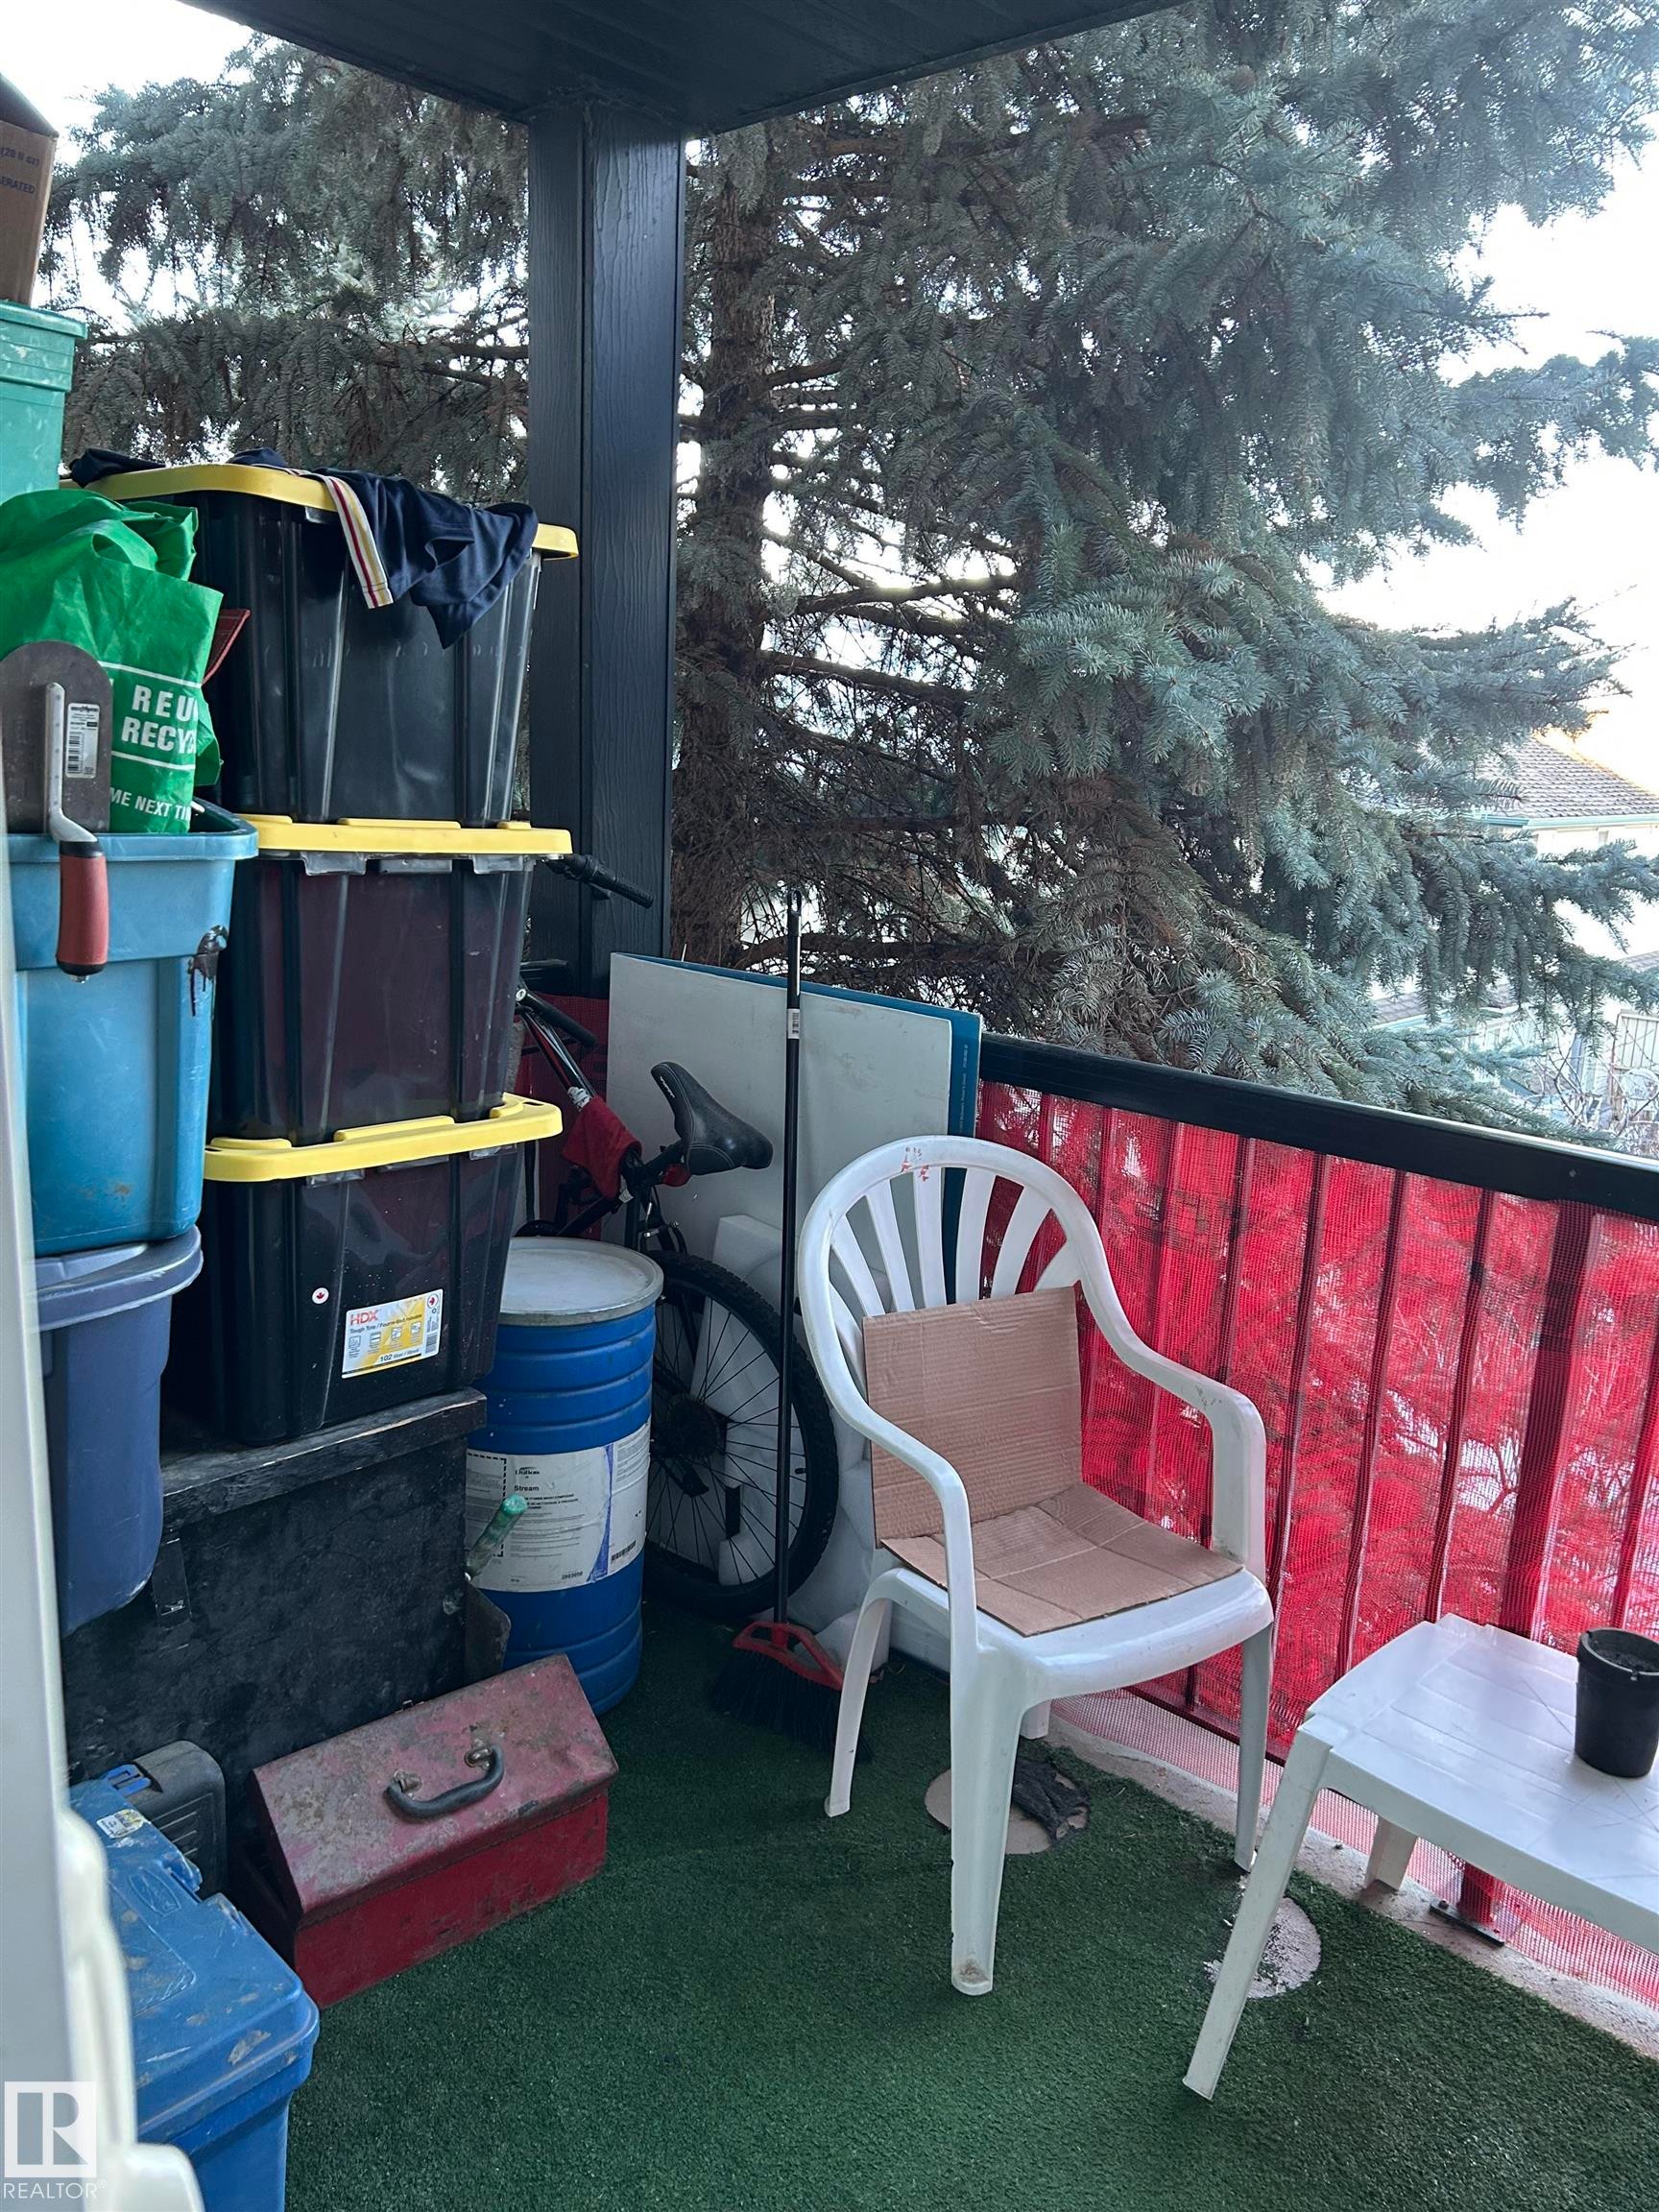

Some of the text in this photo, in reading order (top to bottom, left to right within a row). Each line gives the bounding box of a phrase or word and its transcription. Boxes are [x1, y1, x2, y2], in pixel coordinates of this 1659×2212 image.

[0, 177, 36, 194] ERATED
[134, 795, 173, 818] NEXT
[350, 1310, 378, 1326] HDX
